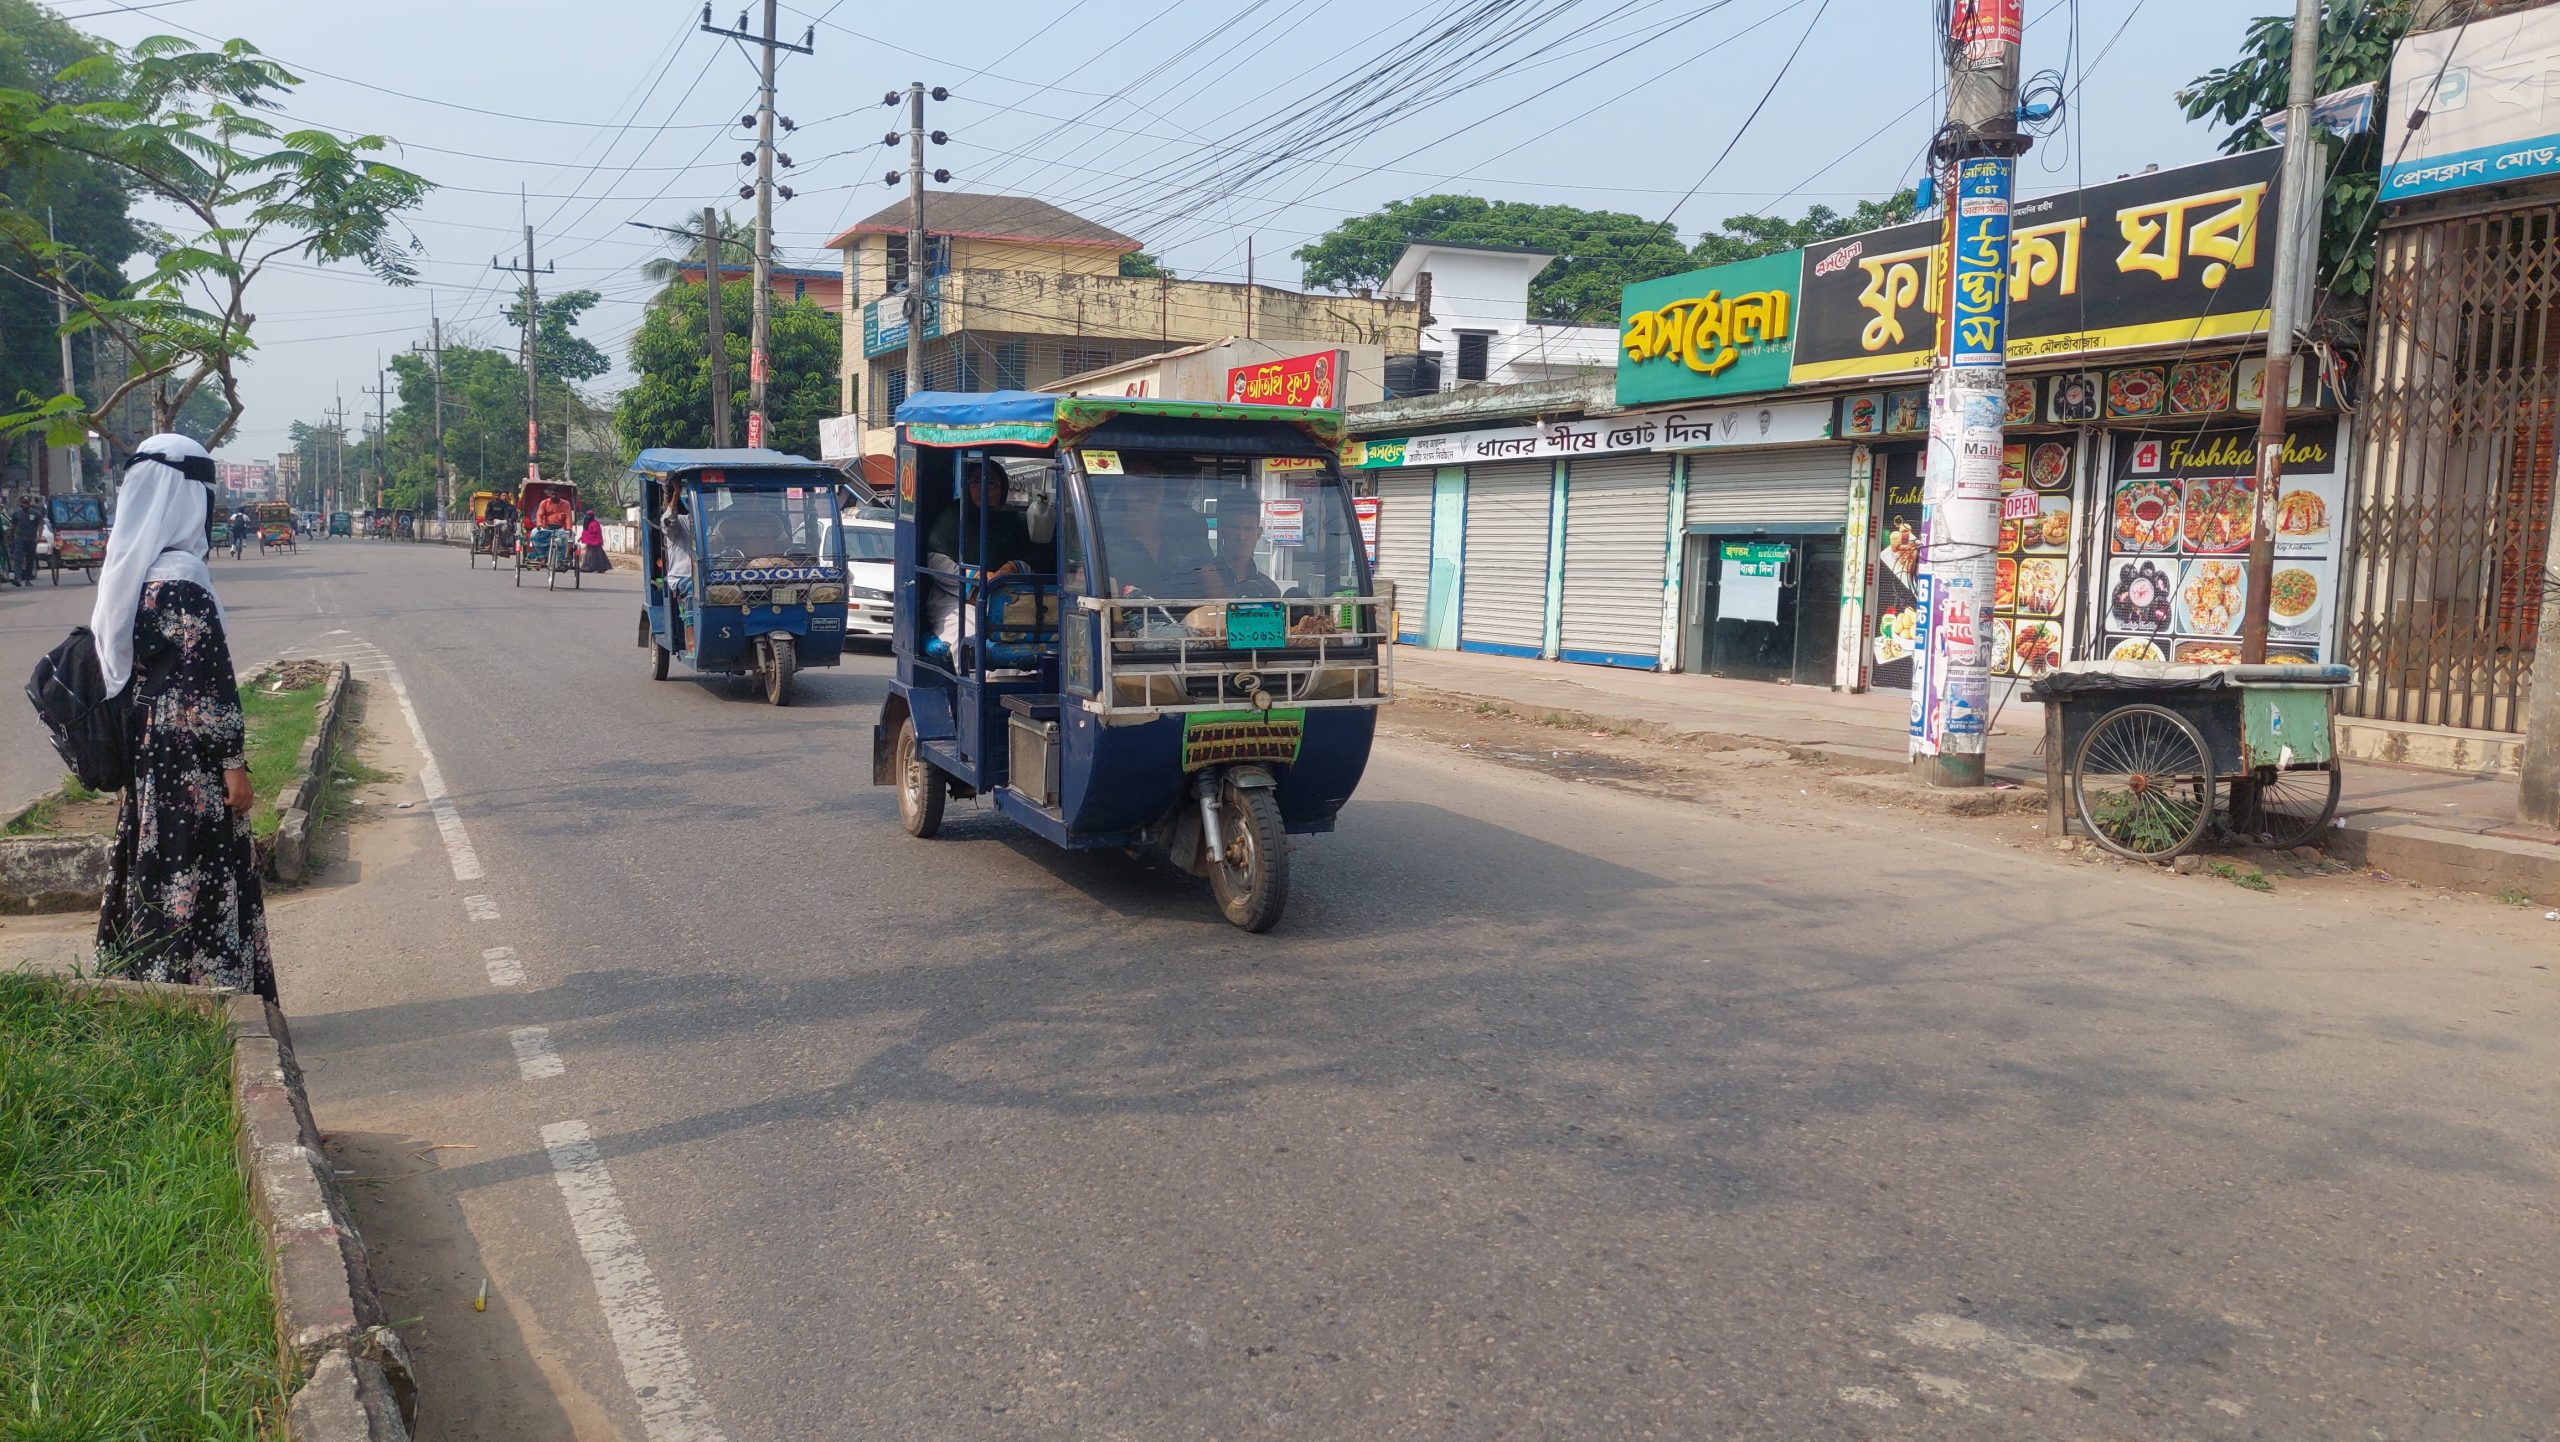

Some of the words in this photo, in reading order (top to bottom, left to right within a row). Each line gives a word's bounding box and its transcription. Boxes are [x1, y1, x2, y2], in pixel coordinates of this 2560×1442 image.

[2393, 159, 2489, 188] প্রেসক্লাব
[1975, 185, 1999, 194] GST
[2115, 181, 2268, 289] ঘর
[1247, 365, 1284, 399] অতিথি
[1287, 370, 1312, 405] ফুড
[1477, 437, 1537, 457] ধানের
[1546, 425, 1598, 452] শীষে
[1606, 421, 1657, 449] ভোট
[1664, 415, 1713, 443] দিন
[2169, 436, 2254, 469] Fushka
[2281, 433, 2327, 463] hor
[2007, 495, 2037, 517] OPEN
[726, 568, 824, 580] TOYOTA
[1758, 561, 1774, 576] দিন
